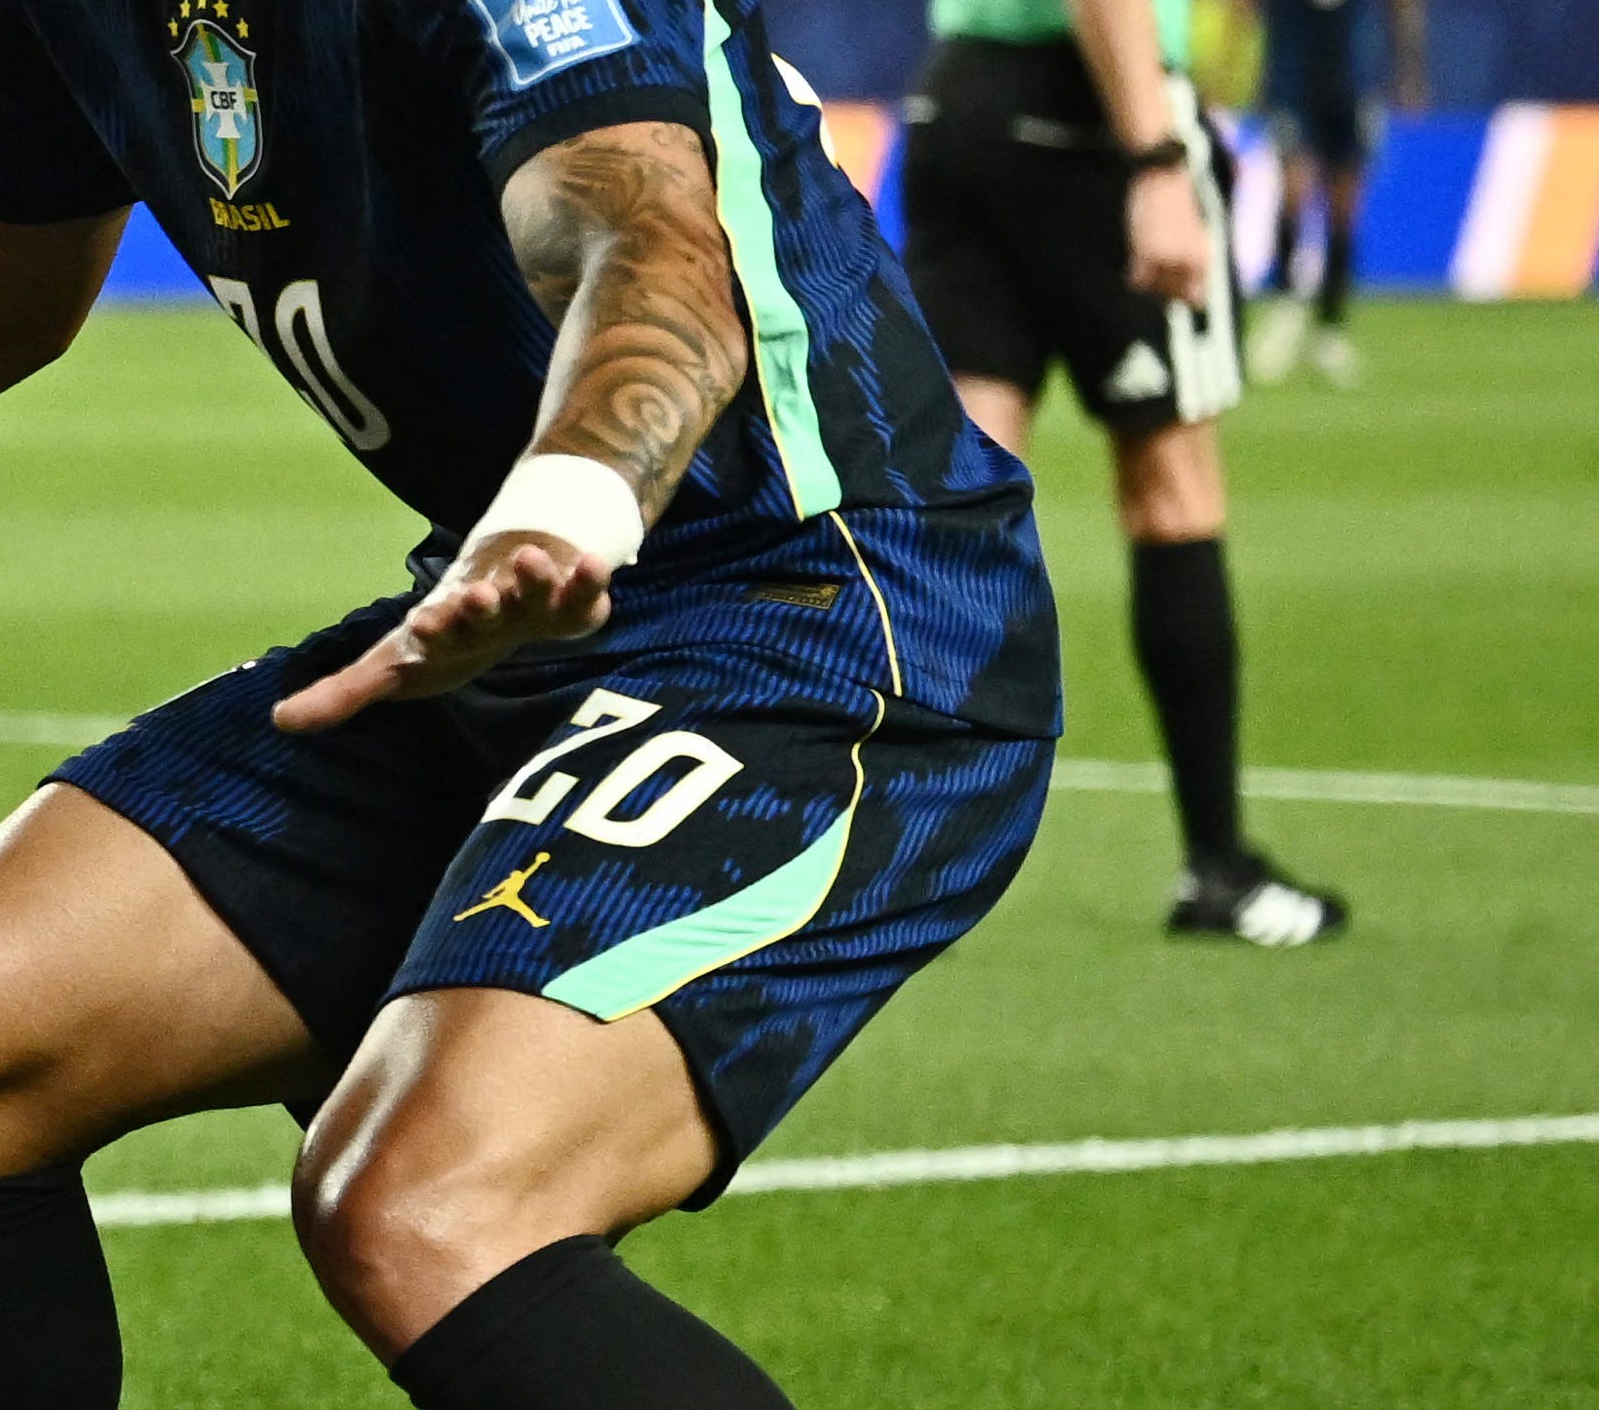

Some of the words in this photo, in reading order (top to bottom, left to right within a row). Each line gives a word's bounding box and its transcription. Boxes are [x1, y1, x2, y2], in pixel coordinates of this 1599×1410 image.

[523, 6, 594, 49] PEACE
[545, 35, 588, 57] FIFA
[210, 89, 240, 113] CBF
[209, 196, 292, 233] BRASIL
[481, 686, 745, 849] 20
